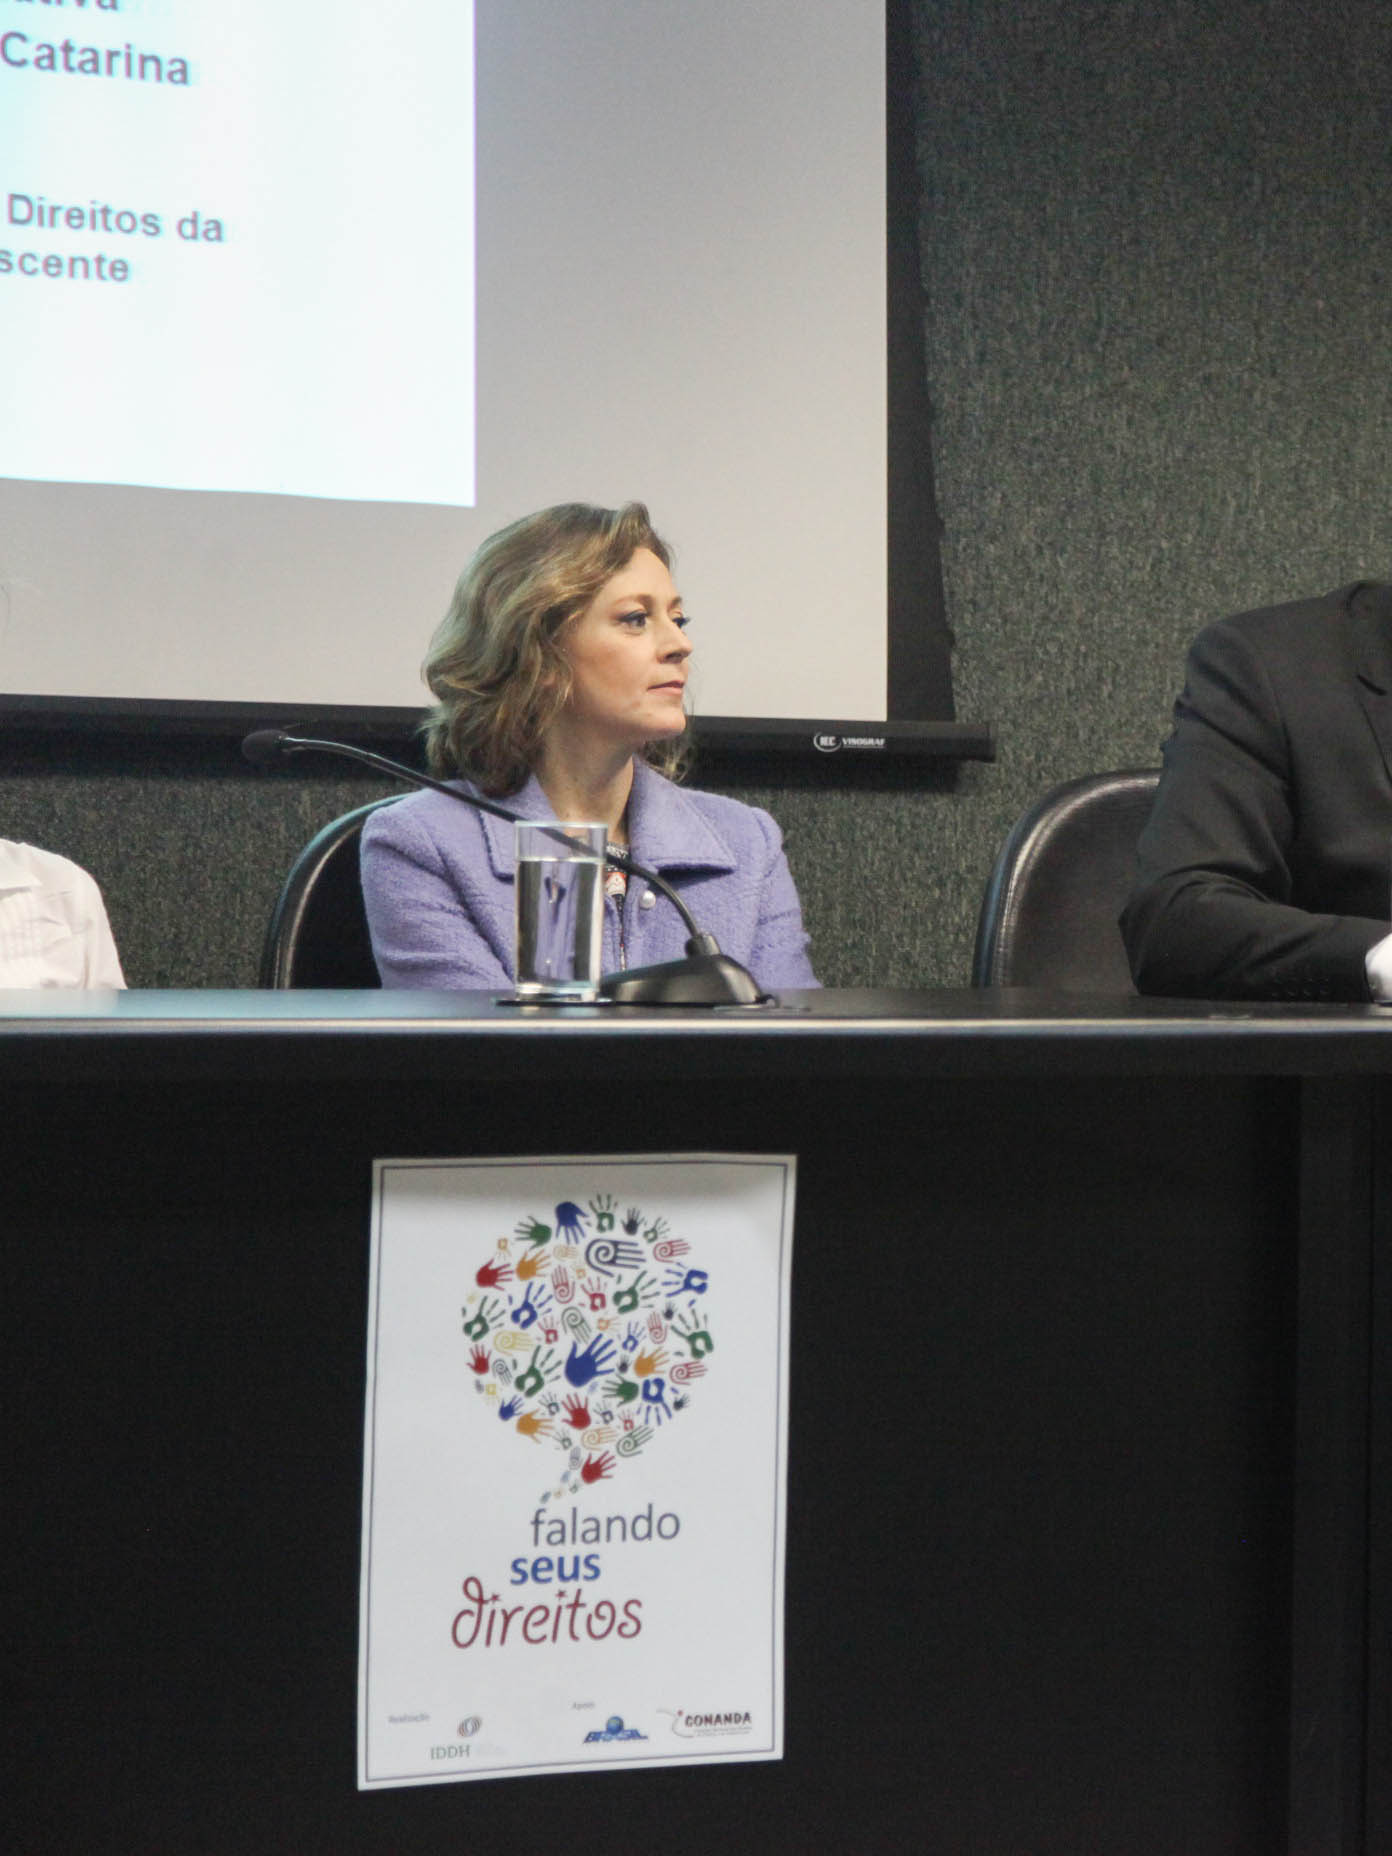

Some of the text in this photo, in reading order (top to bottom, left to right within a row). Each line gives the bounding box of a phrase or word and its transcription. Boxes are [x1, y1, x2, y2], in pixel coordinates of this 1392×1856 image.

[0, 31, 190, 85] Catarina
[7, 193, 224, 242] Direitos da
[530, 1503, 681, 1547] falando
[510, 1553, 601, 1585] seus
[451, 1576, 643, 1649] direitos
[685, 1712, 752, 1728] CONANDA
[430, 1744, 471, 1760] IDDH
